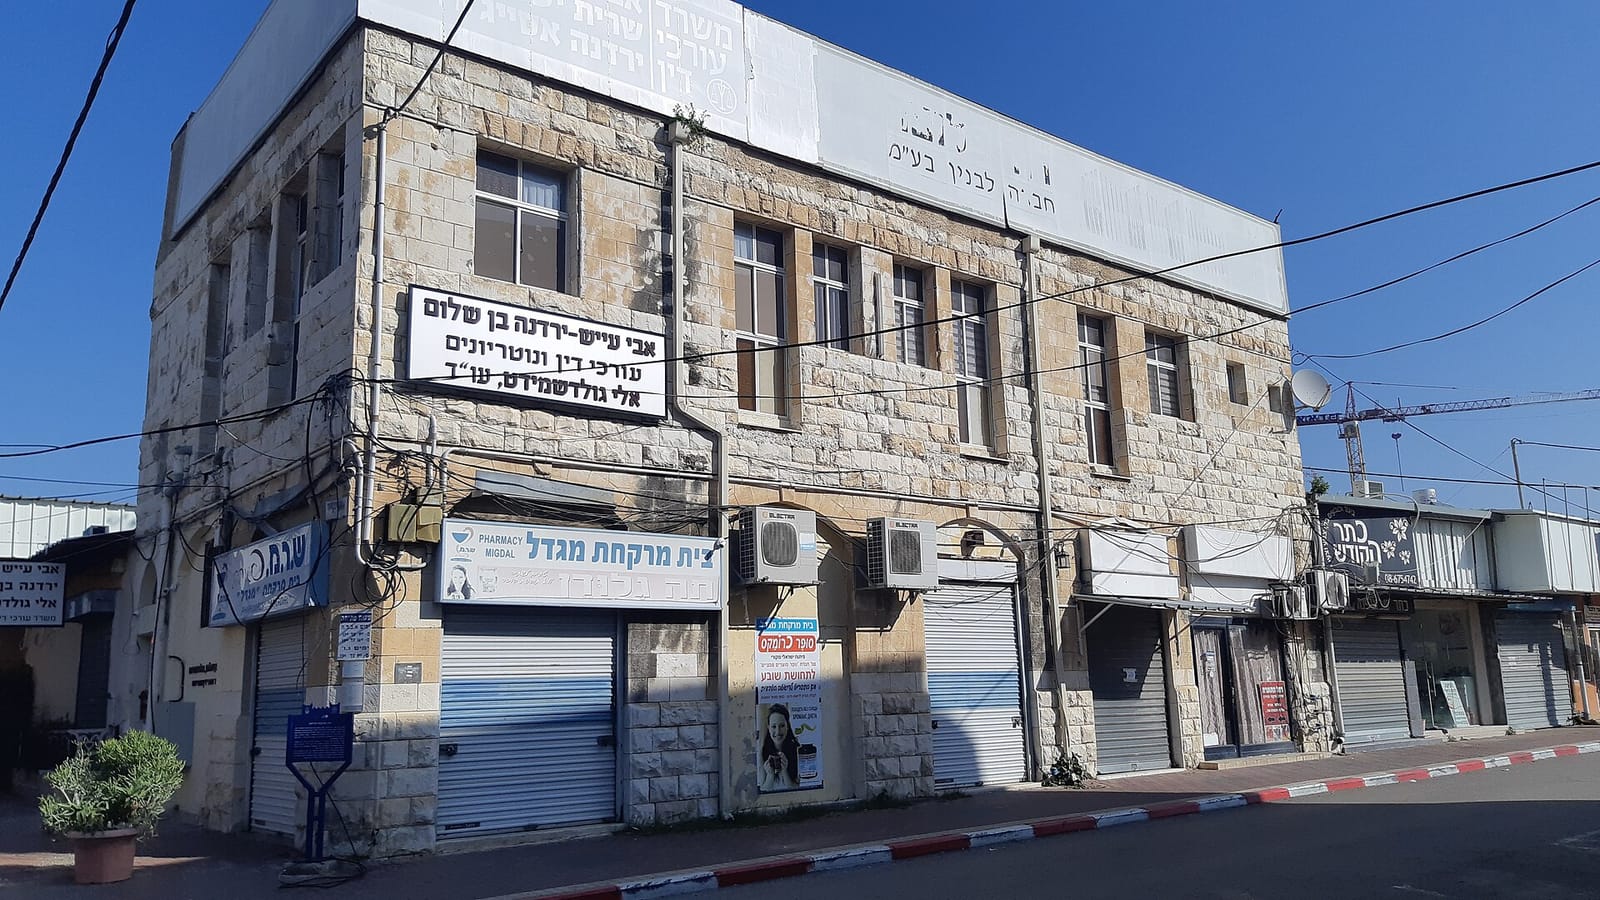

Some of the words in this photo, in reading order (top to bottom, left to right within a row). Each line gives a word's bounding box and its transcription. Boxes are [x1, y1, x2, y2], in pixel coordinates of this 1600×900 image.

[574, 0, 643, 41] שרית
[655, 0, 733, 51] משרד
[570, 28, 644, 72] ירדנה
[656, 29, 727, 76] עורכי
[657, 59, 692, 94] דין
[948, 161, 995, 192] לבנין
[424, 297, 481, 325] שלום
[487, 310, 510, 332] בן
[446, 334, 548, 366] ונוטריונים
[626, 336, 656, 357] אבי
[556, 354, 583, 373] דין
[588, 358, 642, 382] עורכי
[497, 371, 607, 403] גולדשמידט,
[612, 385, 641, 407] אלי
[769, 512, 796, 520] ELECTRA
[895, 521, 919, 529] ELECTRA
[478, 534, 523, 545] PHARMACY
[1333, 519, 1368, 543] כתר
[485, 548, 516, 559] MIGDAL
[526, 531, 586, 563] מגדל
[591, 540, 671, 570] מרקחת
[676, 547, 714, 568] בית
[1333, 539, 1382, 565] הקודש
[2, 564, 32, 573] עייש
[37, 565, 60, 574] אבי
[19, 582, 58, 591] ירדנה
[0, 596, 30, 608] גולד
[36, 596, 57, 608] אלי
[778, 621, 801, 631] מרקחת
[803, 621, 814, 629] בית
[795, 637, 814, 650] סופר
[761, 671, 781, 681] שובע
[784, 668, 816, 680] לתחושת
